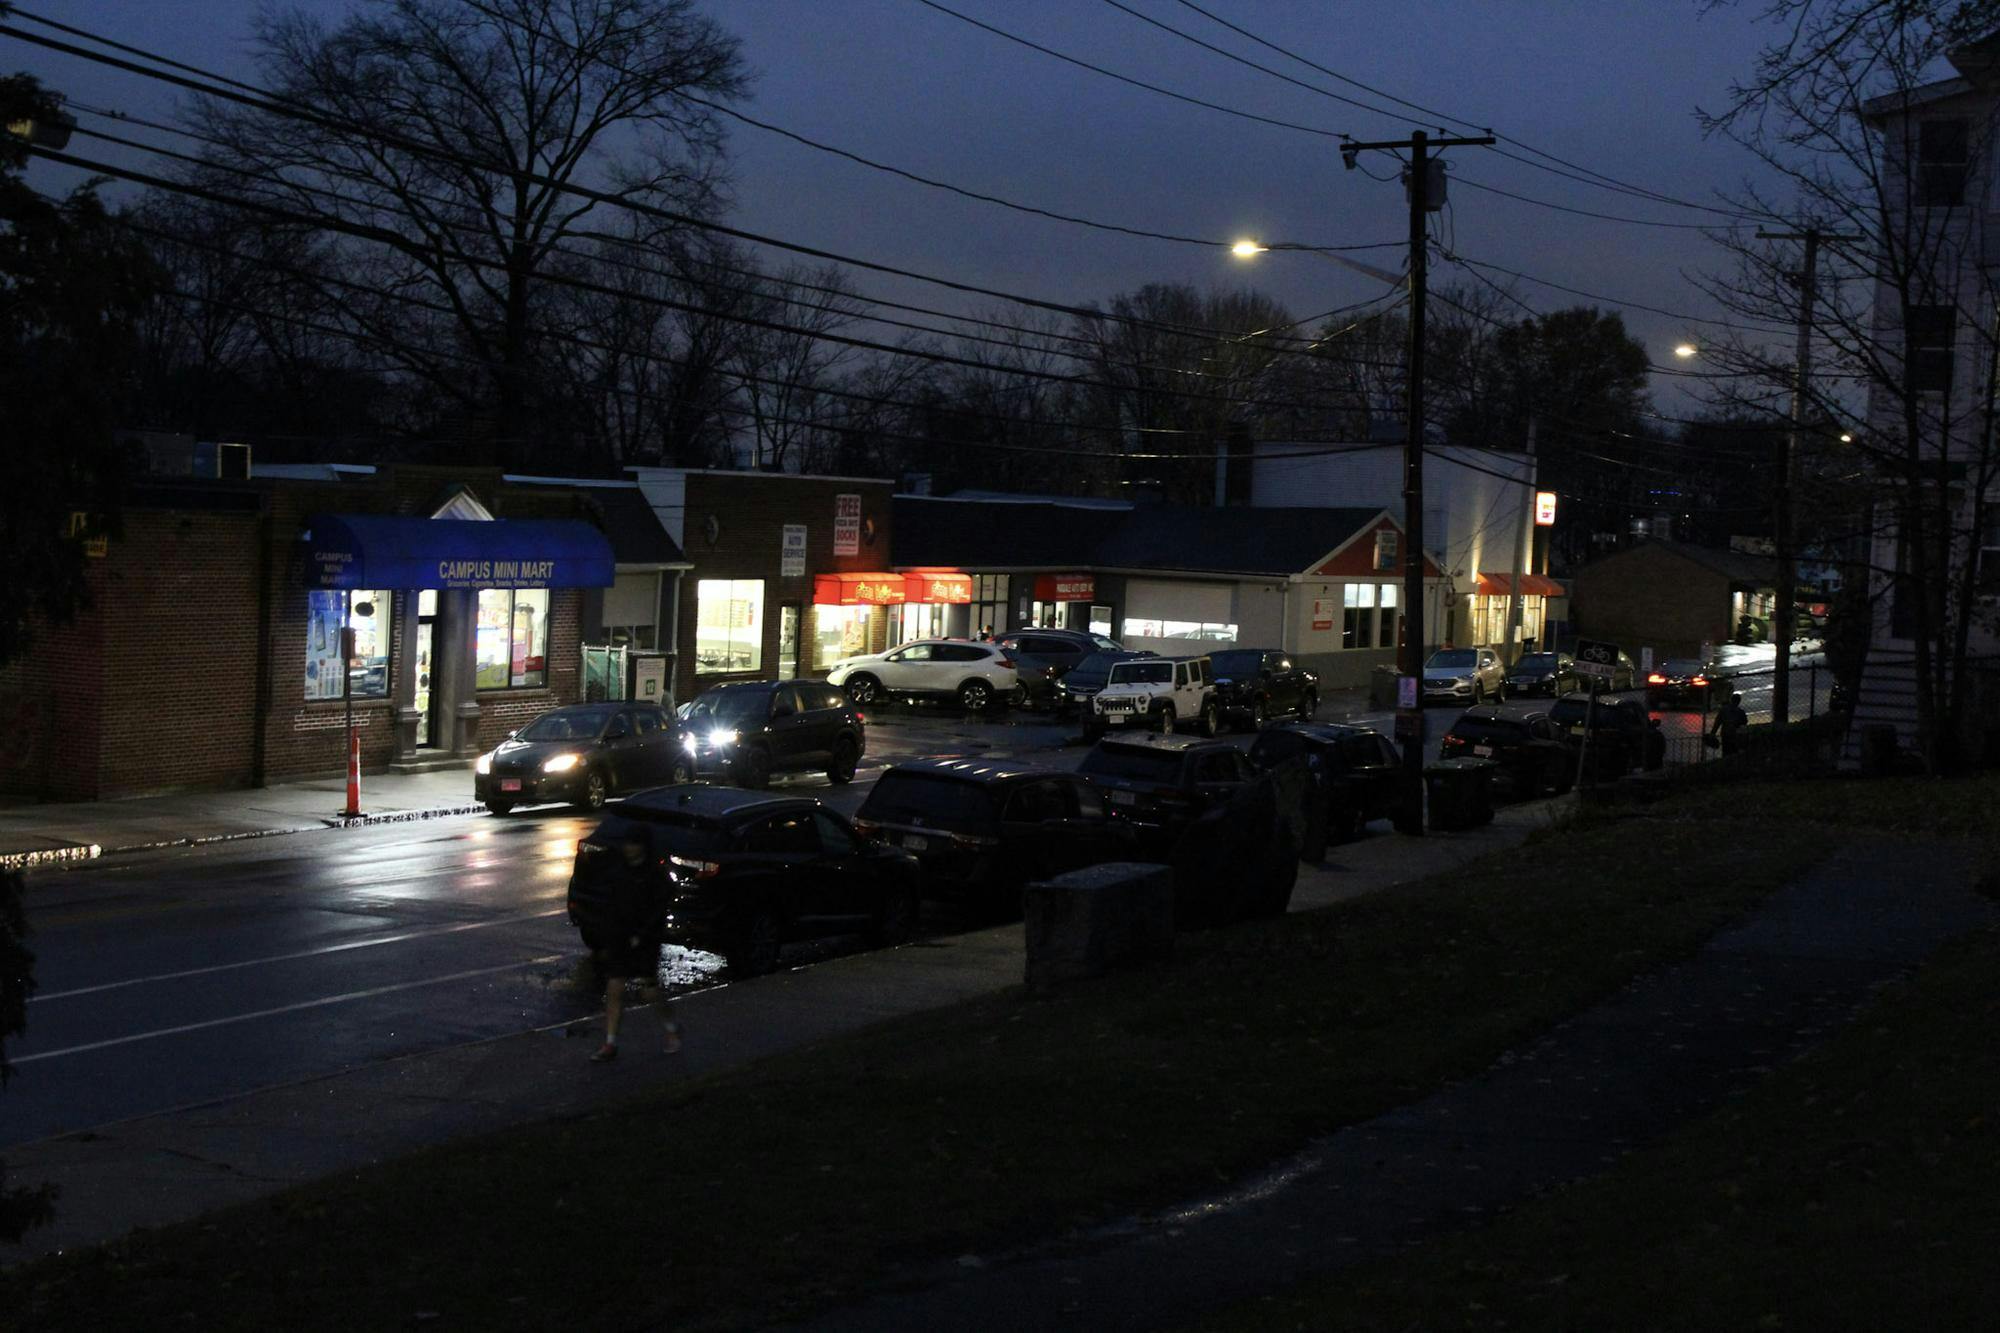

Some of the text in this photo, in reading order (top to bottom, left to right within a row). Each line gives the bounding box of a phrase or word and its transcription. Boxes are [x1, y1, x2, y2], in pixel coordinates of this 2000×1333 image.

[835, 496, 860, 517] FREE
[788, 535, 802, 546] AUTO
[836, 529, 857, 542] SOCKS
[314, 551, 353, 563] CAMPUS
[783, 548, 805, 559] SERVICE
[323, 563, 344, 574] MINI
[439, 561, 554, 579] CAMPUS MINI MART
[319, 575, 348, 585] MART
